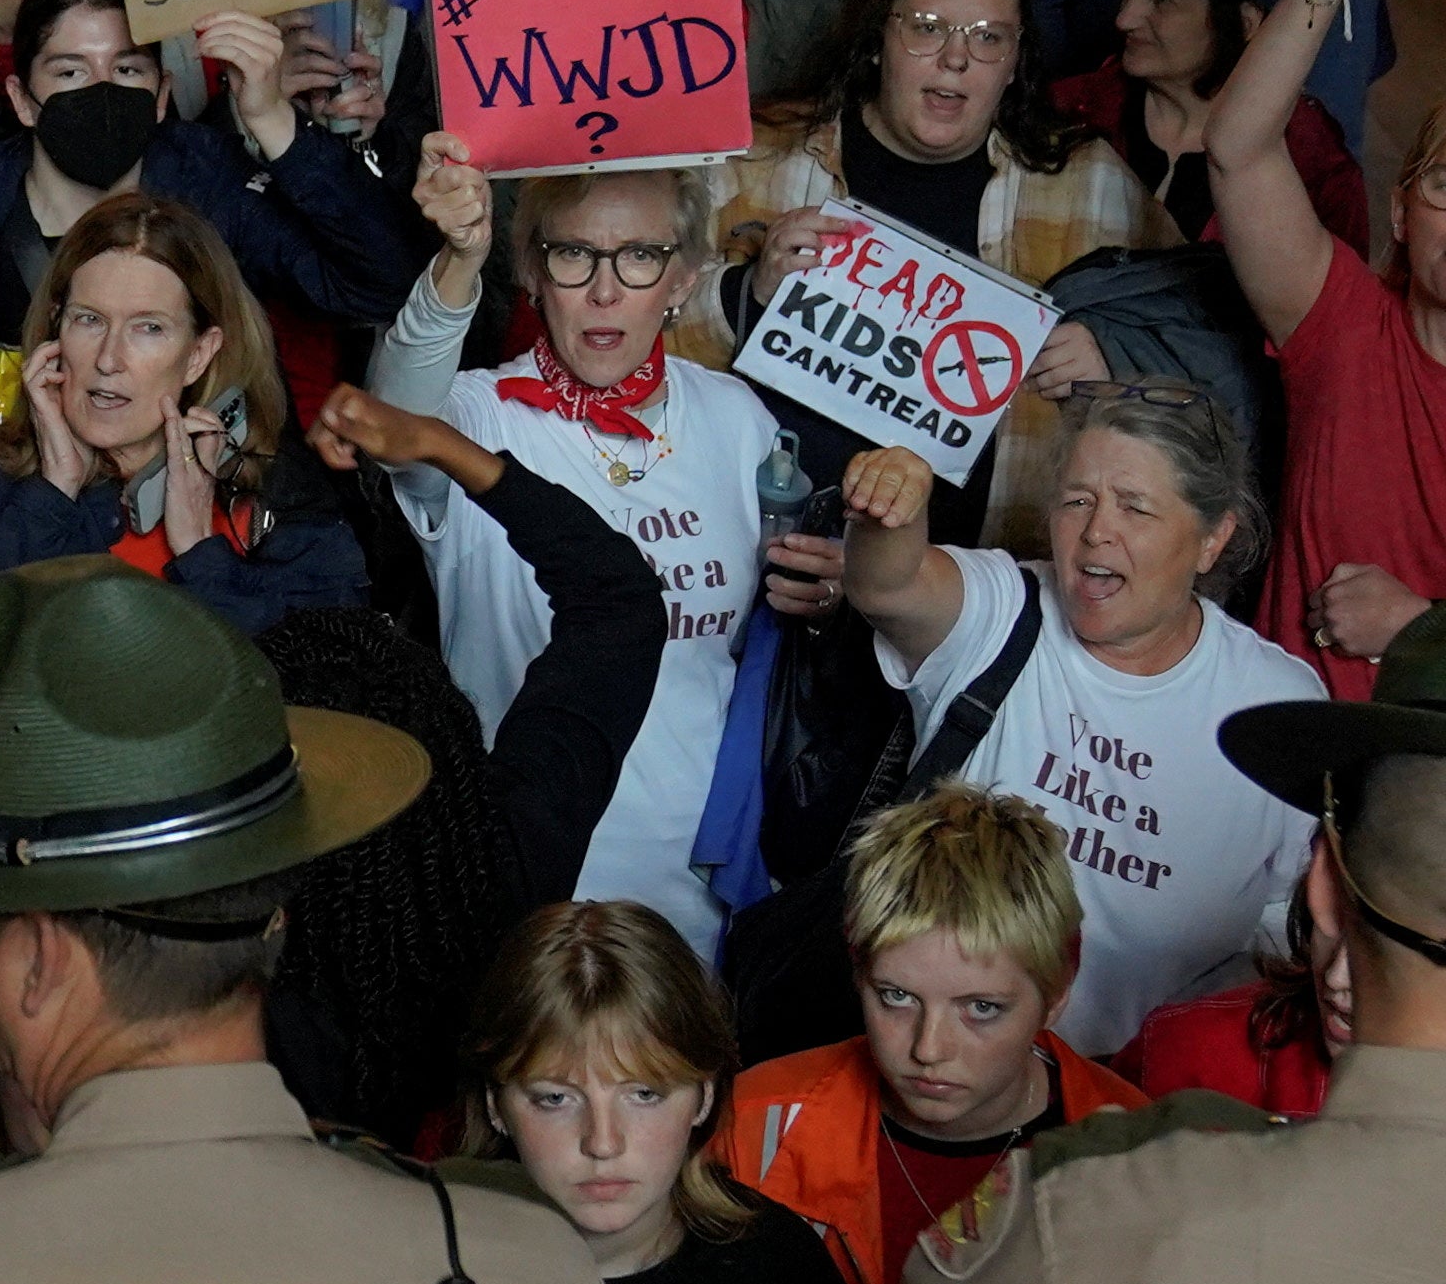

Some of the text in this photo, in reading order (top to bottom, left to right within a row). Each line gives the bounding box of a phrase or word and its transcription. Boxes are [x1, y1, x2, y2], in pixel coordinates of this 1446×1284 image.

[452, 13, 737, 110] WWJD
[575, 110, 620, 156] ?
[778, 280, 924, 379] KIDS
[610, 506, 704, 543] Vote
[704, 559, 728, 589] a
[1068, 713, 1153, 780] Vote
[1031, 750, 1162, 836] Like a
